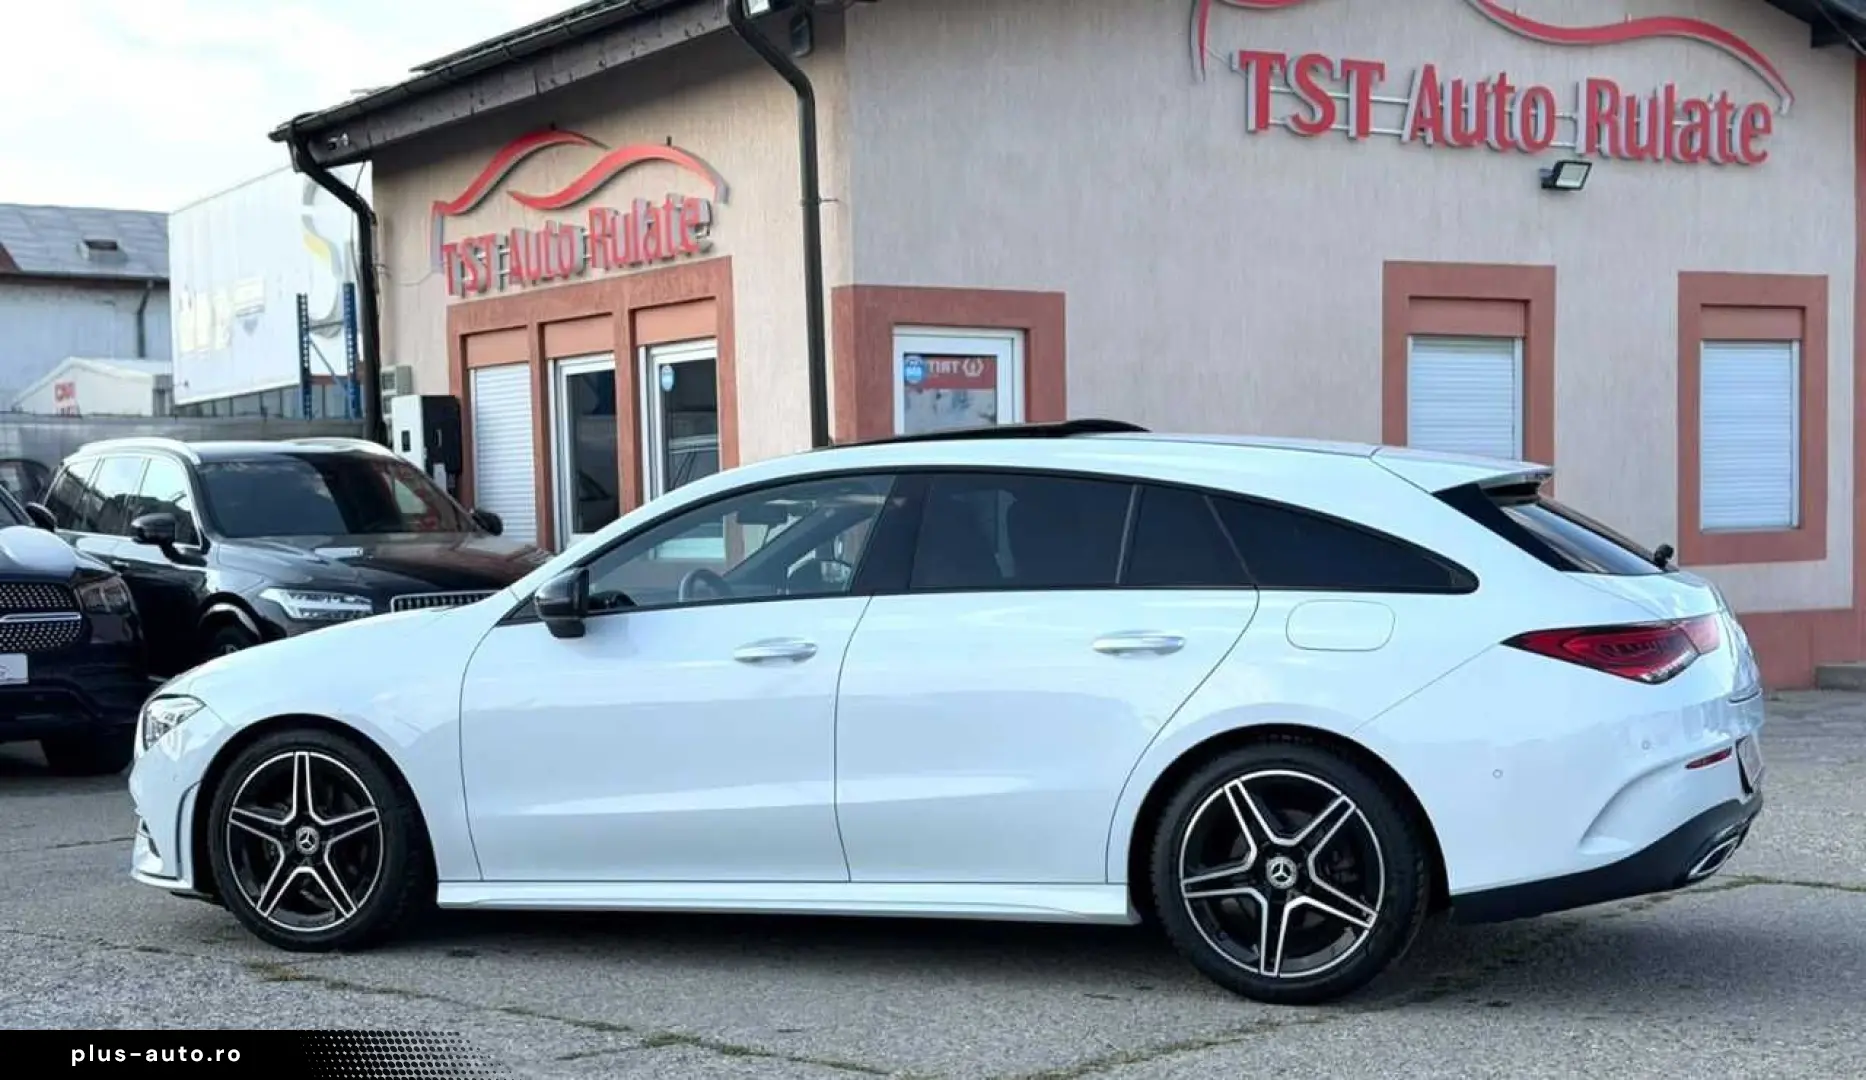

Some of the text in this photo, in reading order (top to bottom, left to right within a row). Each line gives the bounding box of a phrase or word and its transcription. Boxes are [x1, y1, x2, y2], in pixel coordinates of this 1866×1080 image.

[1234, 49, 1773, 165] TST Auto Rulate
[442, 193, 712, 298] TST Auto Rulate
